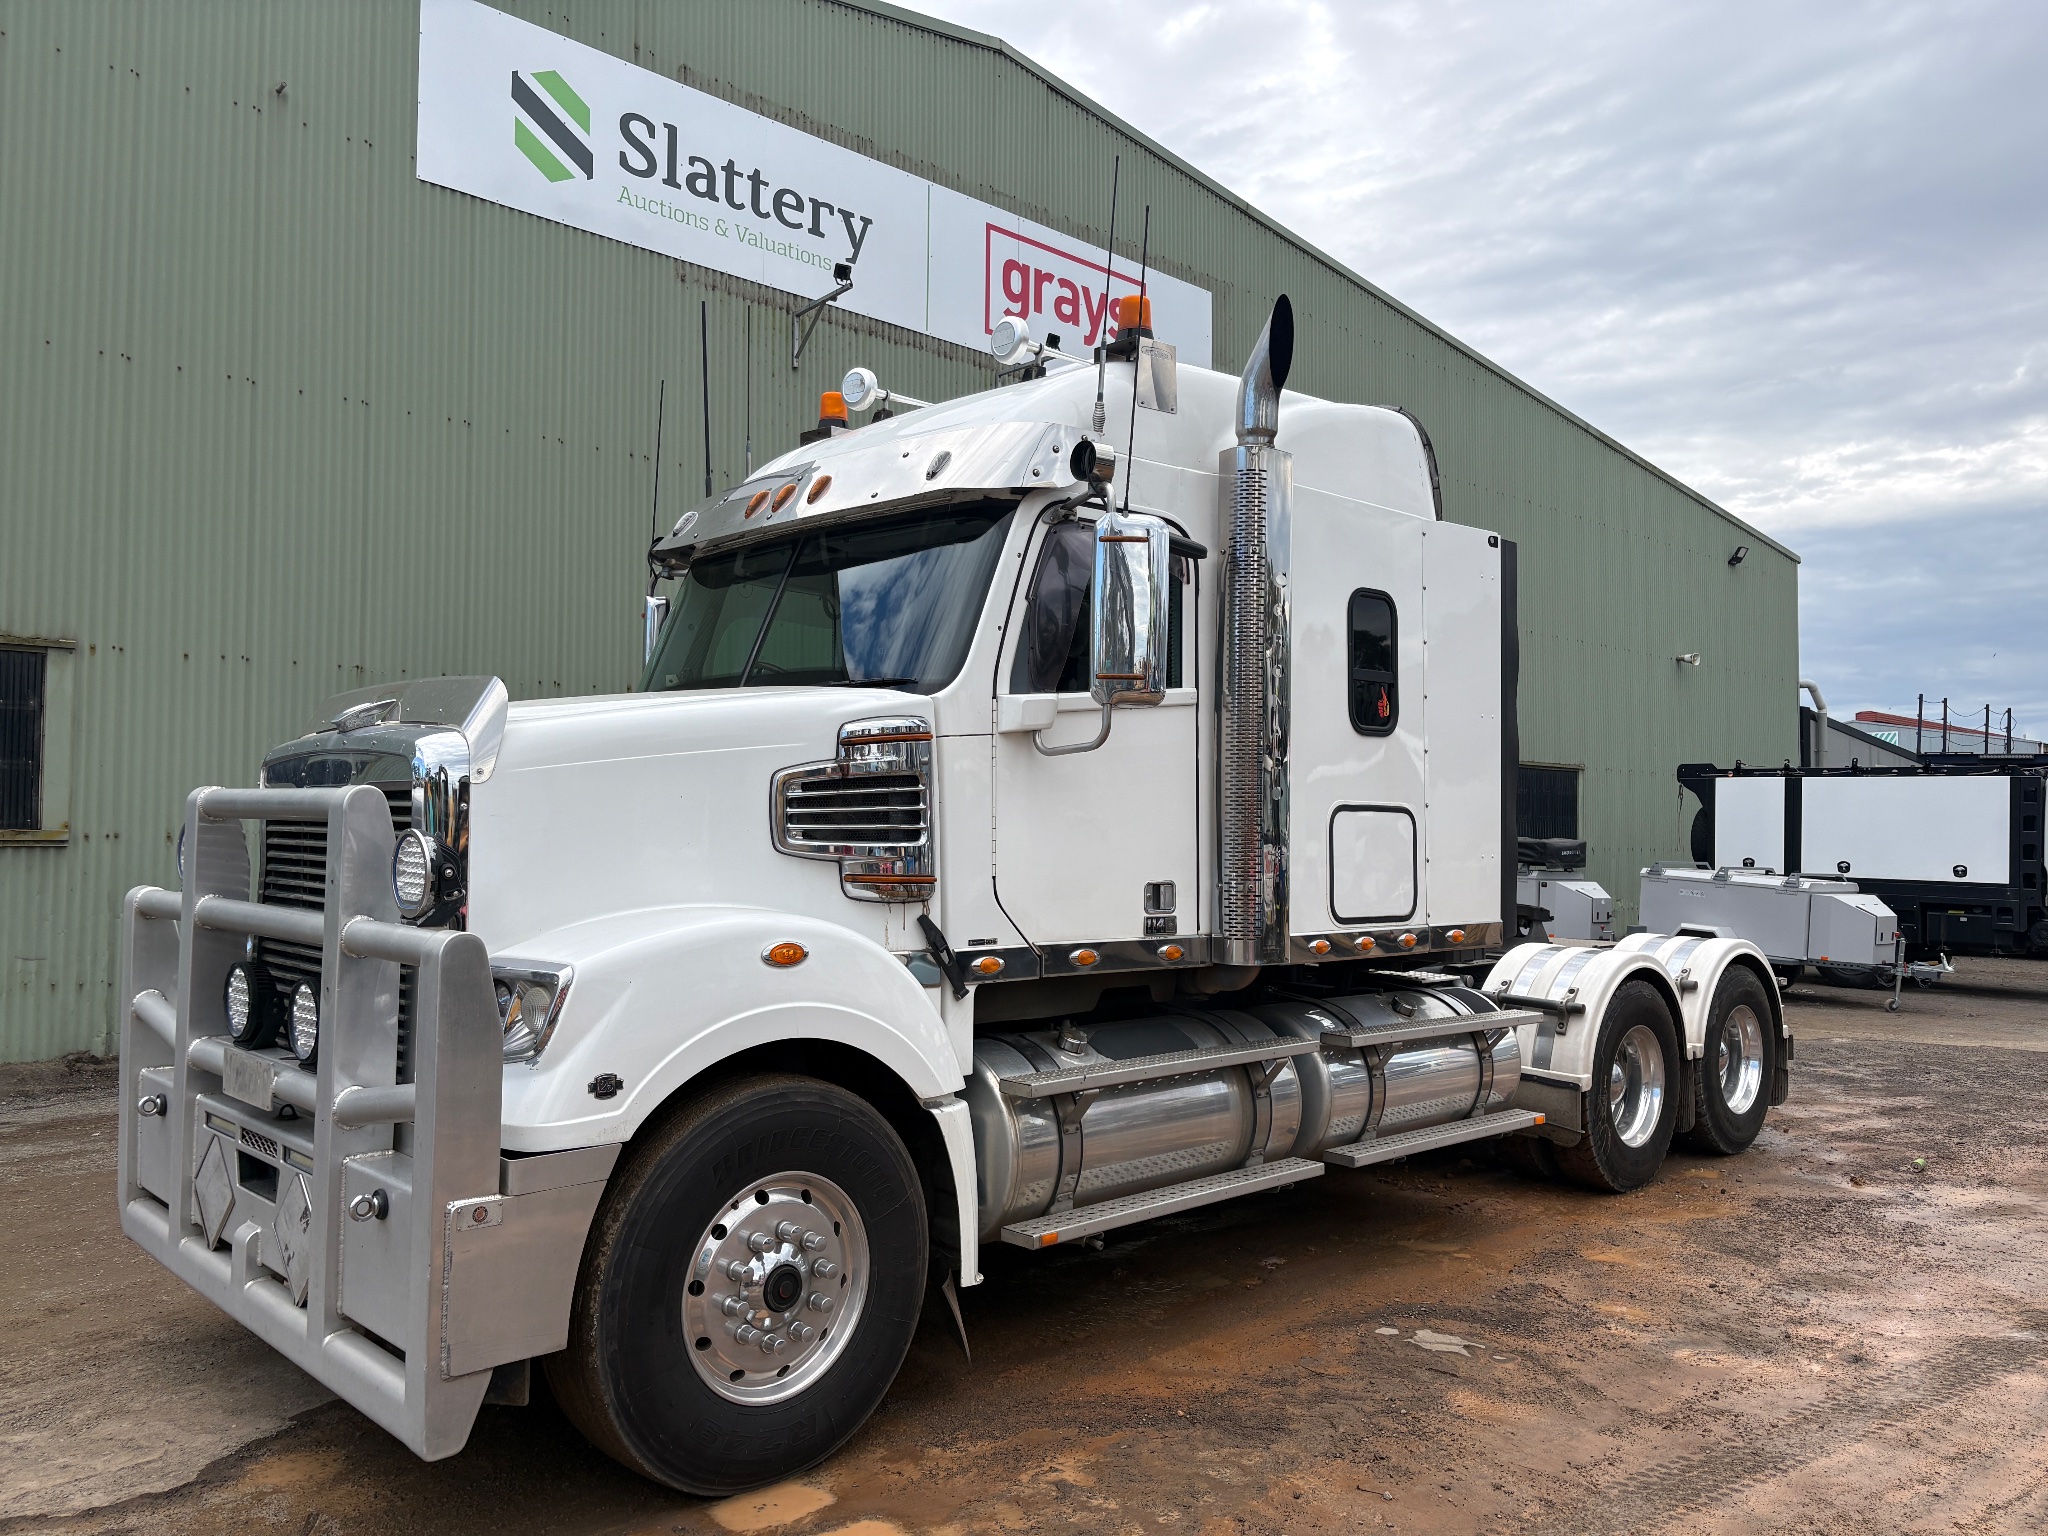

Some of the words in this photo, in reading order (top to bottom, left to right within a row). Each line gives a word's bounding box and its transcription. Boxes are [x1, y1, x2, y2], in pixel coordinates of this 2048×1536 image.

[617, 185, 709, 232] Auctions
[714, 218, 729, 239] &
[734, 223, 832, 271] Valuations
[619, 112, 873, 264] Slattery
